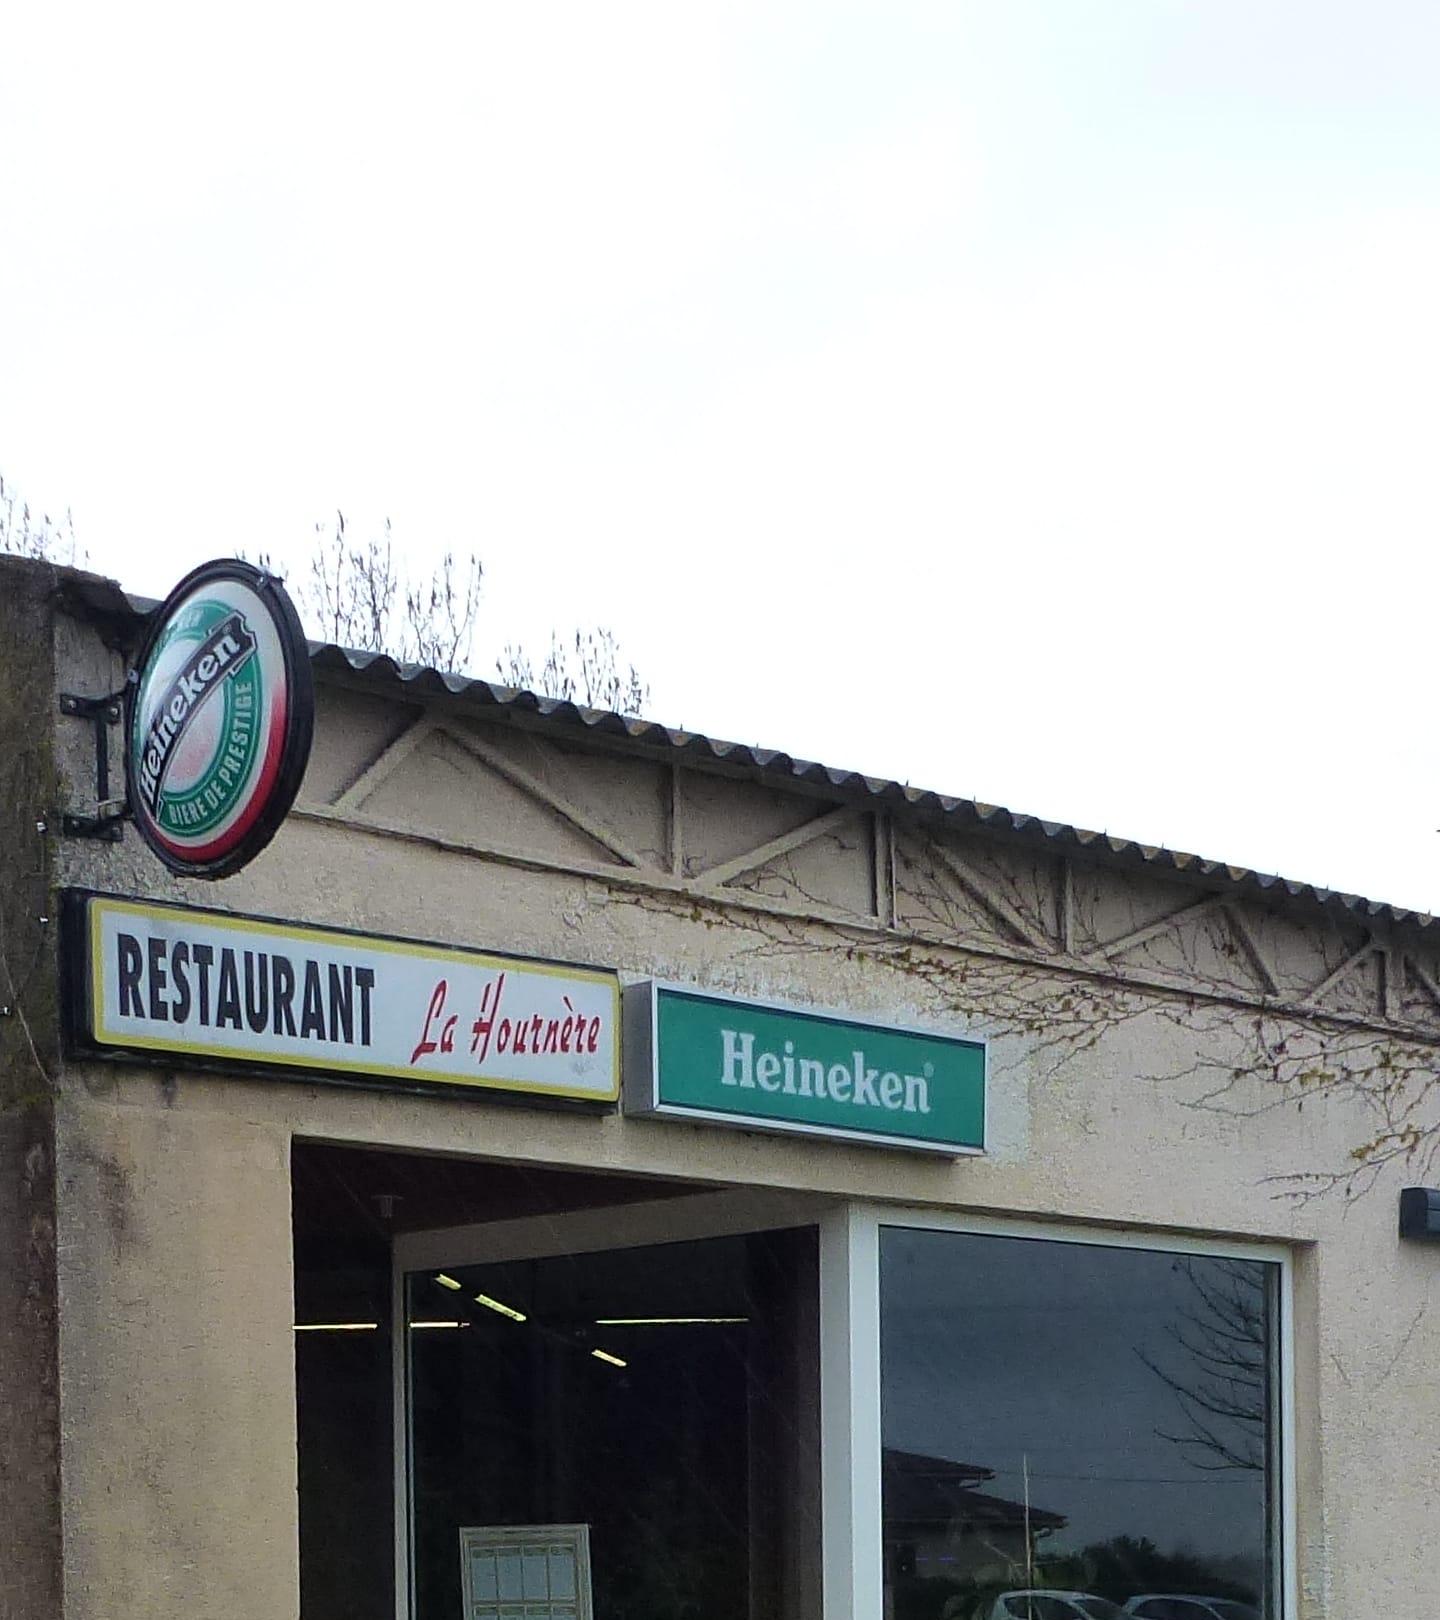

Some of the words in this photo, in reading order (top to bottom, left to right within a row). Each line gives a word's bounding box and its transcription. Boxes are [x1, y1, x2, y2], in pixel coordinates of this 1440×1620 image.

[140, 633, 240, 804] Heineken
[204, 780, 226, 808] DE
[218, 682, 252, 787] PRESTIGE
[117, 932, 375, 1047] RESTAURANT
[410, 979, 458, 1065] La
[470, 972, 601, 1065] Hournère
[720, 1029, 932, 1115] Heineken
